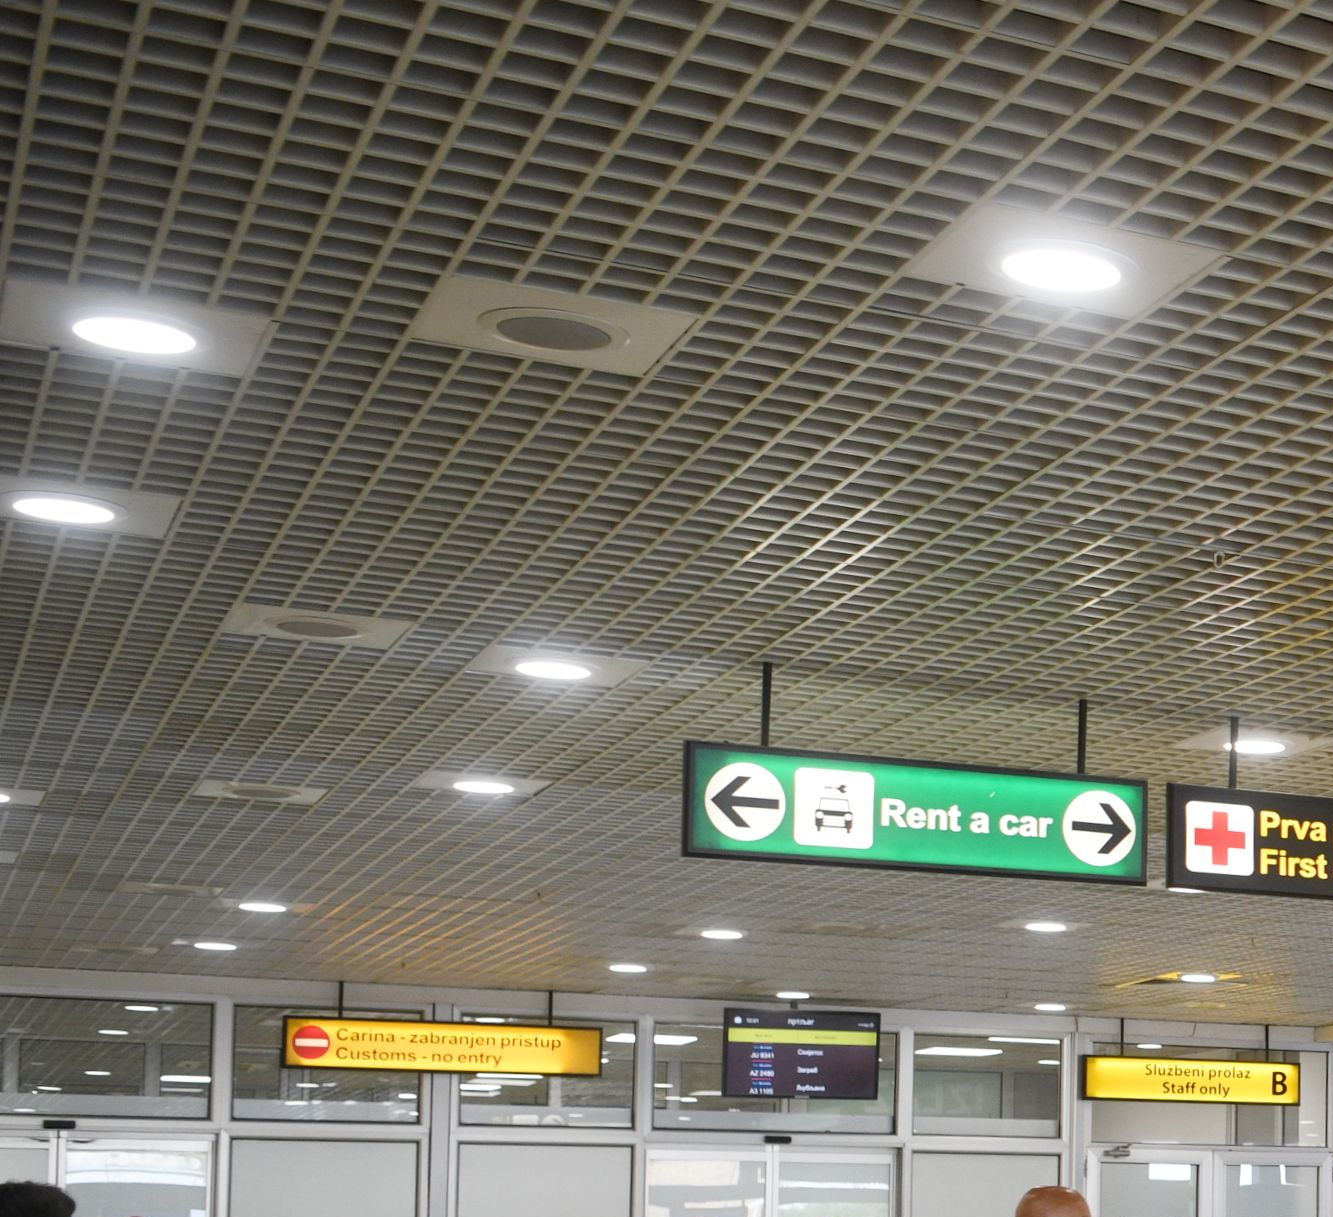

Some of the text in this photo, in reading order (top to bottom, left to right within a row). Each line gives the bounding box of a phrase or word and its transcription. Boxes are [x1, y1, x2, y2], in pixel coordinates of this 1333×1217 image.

[881, 797, 1053, 838] Rent a car
[1259, 811, 1326, 843] Prva
[1259, 849, 1327, 880] First
[336, 1028, 395, 1043] Carina
[410, 1032, 497, 1048] zabranjen
[501, 1036, 561, 1051] pristup
[336, 1047, 417, 1061] Customs
[432, 1053, 453, 1064] no
[460, 1053, 502, 1066] entry
[1145, 1063, 1288, 1096] Službeni prolaz B
[1163, 1081, 1230, 1098] Staff only
